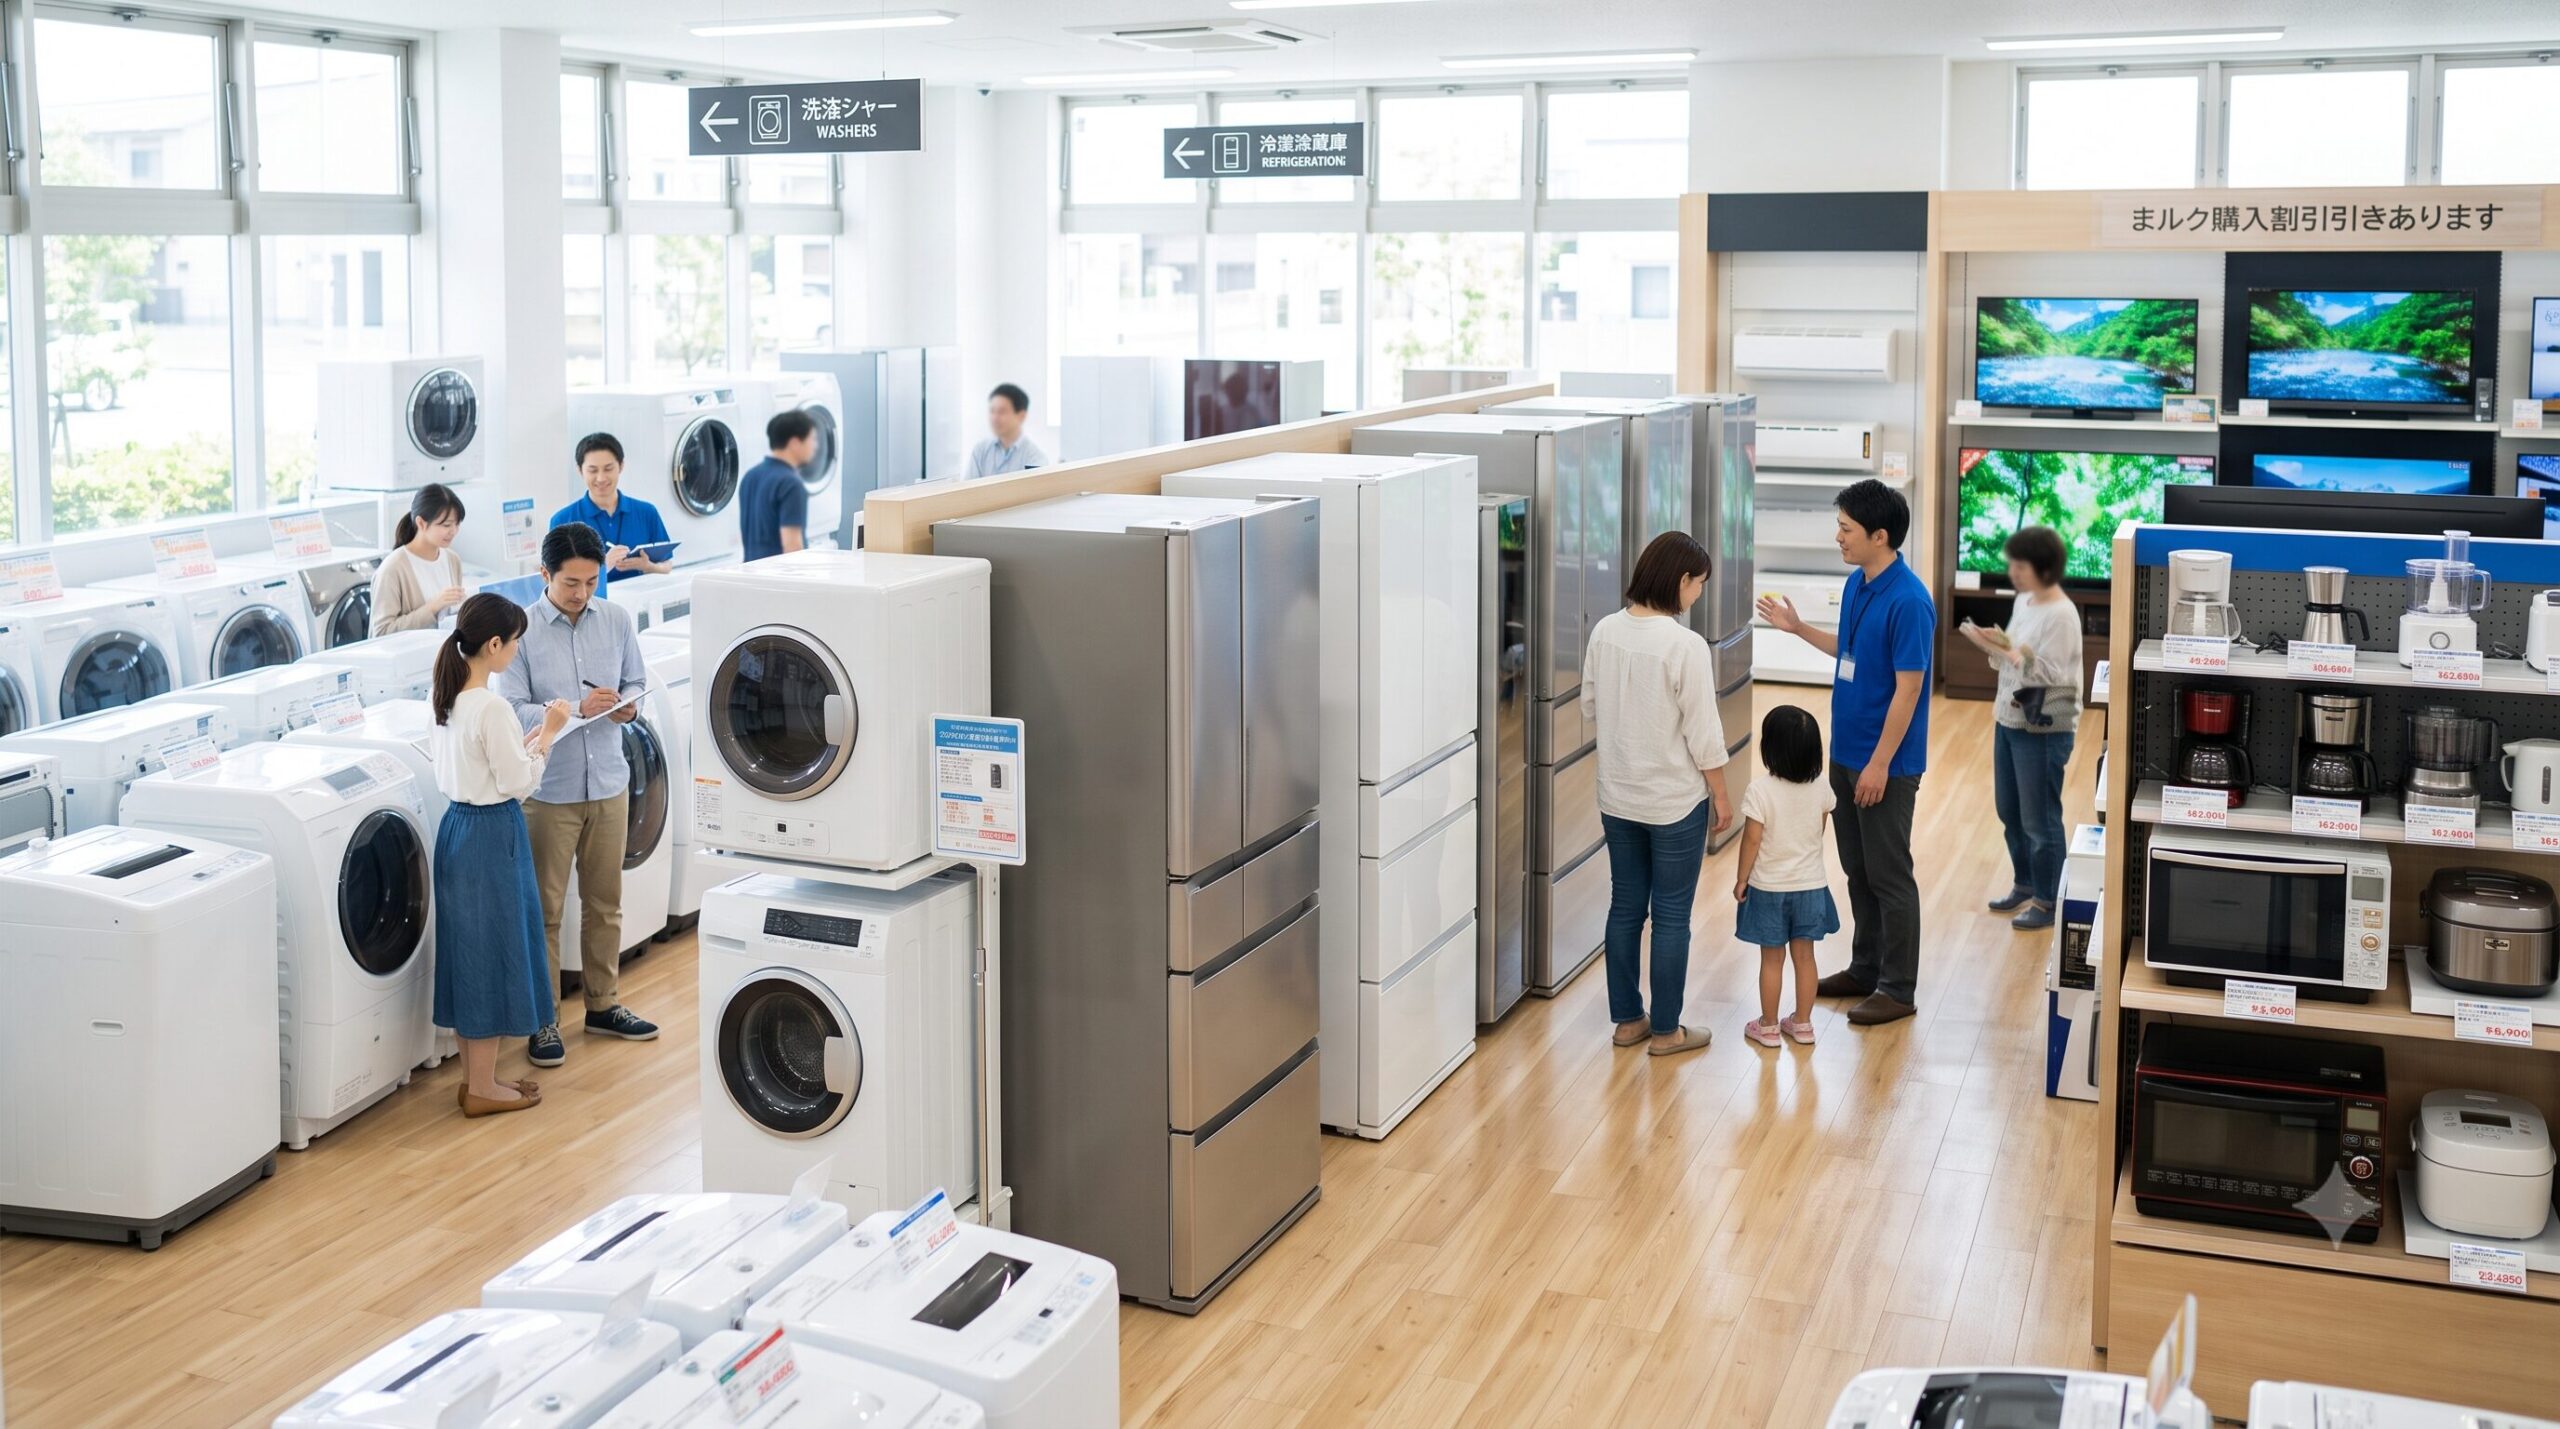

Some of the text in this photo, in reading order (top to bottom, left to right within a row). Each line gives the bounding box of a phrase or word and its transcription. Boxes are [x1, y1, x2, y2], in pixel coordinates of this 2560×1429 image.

[816, 124, 877, 139] WASHERS
[2132, 203, 2504, 232] まルク購入割引引きあります
